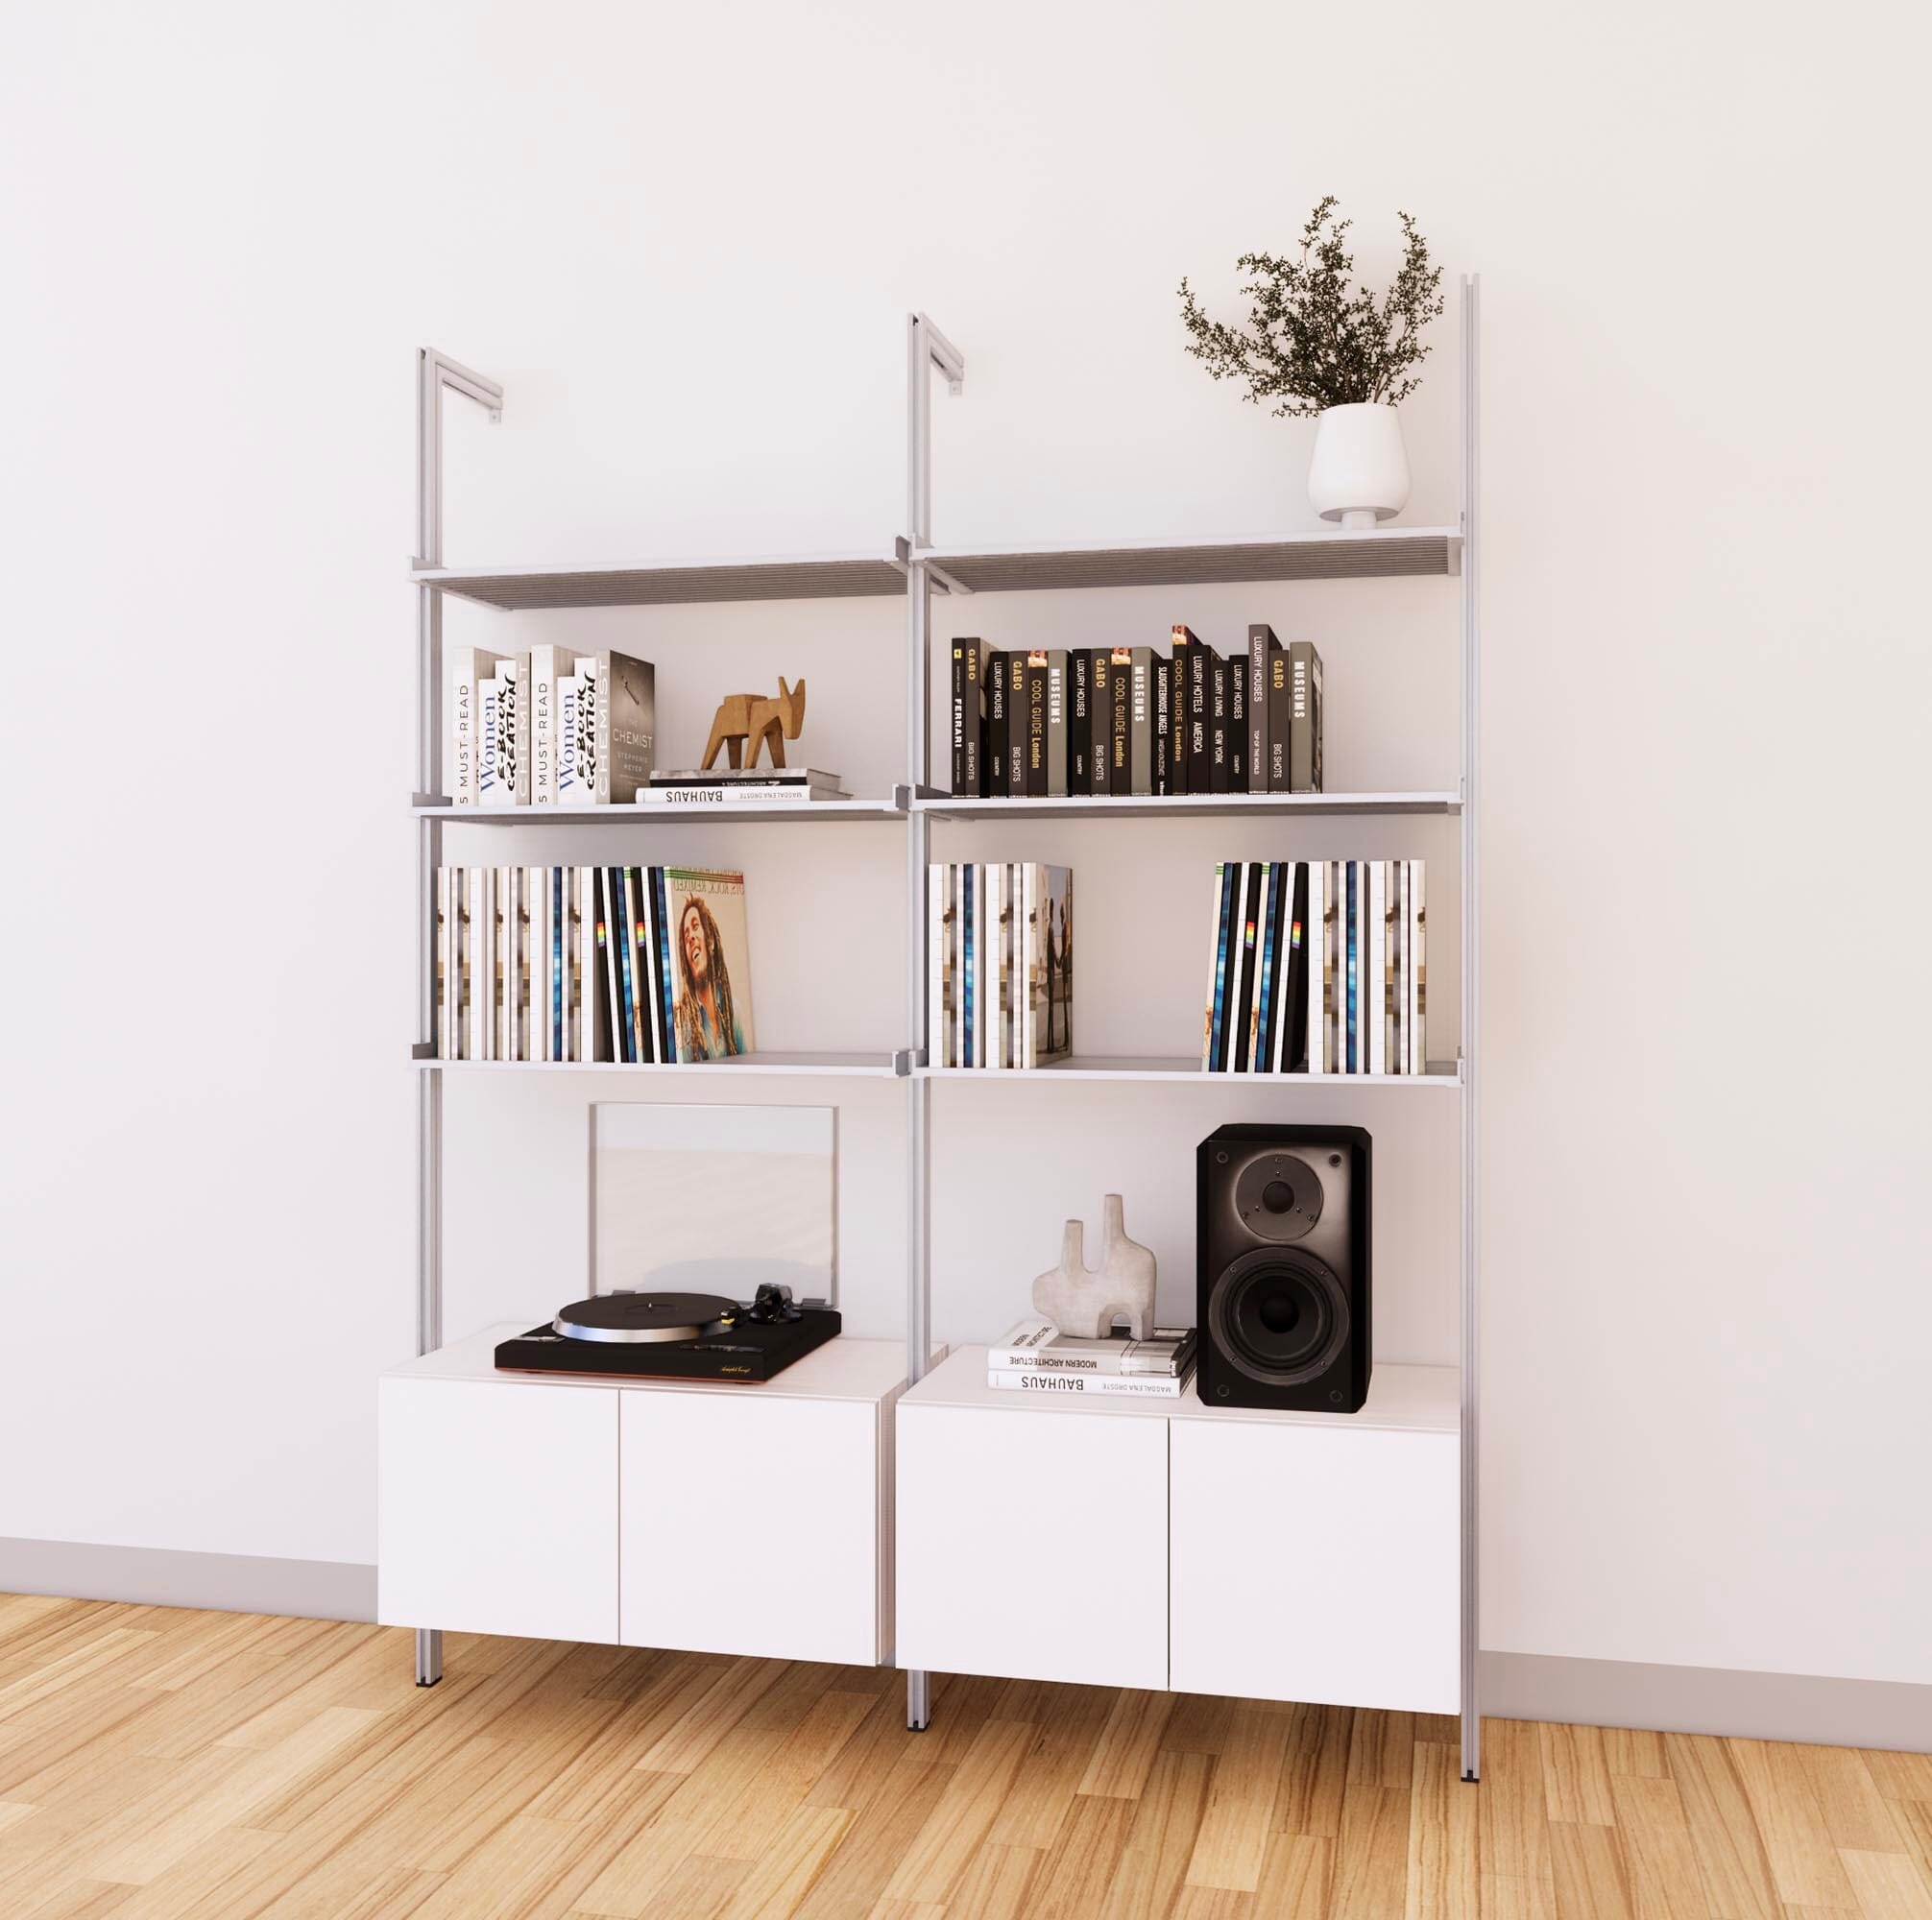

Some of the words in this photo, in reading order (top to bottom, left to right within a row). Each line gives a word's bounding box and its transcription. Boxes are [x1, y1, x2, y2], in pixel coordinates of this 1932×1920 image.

[1254, 636, 1262, 667] LUXURY
[994, 662, 1002, 690] LUXURY
[1013, 661, 1022, 690] GABO
[1077, 660, 1085, 687] LUXURY
[1096, 659, 1105, 688] GABO
[1193, 656, 1202, 684] LUXURY
[1215, 670, 1223, 695] LUXURY
[1234, 665, 1242, 691] LUXURY
[1273, 661, 1283, 689] GABO
[1032, 680, 1041, 704] COOL
[1051, 668, 1061, 724] MUSEUMS
[1115, 677, 1125, 702] COOL
[1135, 666, 1145, 722] MUSEUMS
[1193, 686, 1202, 713] HOTELS
[1254, 669, 1262, 702] HOUSES
[1295, 662, 1305, 718] MUSEUMS
[994, 691, 1002, 720] HOUSES
[1077, 688, 1085, 717] HOUSES
[1215, 696, 1223, 717] LIVING
[1234, 692, 1242, 720] HOUSES
[497, 685, 507, 779] E-BOOK
[504, 671, 516, 792] CREATION
[519, 663, 529, 796] CHEMIST
[577, 684, 587, 779] E-BOOK
[584, 671, 596, 791] CREATION
[598, 660, 607, 796] CHEMIST
[954, 698, 962, 747] FERRARI
[1032, 707, 1041, 734] GUIDE
[1115, 705, 1125, 732] GUIDE
[1158, 715, 1167, 735] ANGELS
[459, 684, 469, 787] MUST-READ
[480, 696, 496, 792] Women
[538, 683, 547, 786] MUST-READ
[559, 694, 575, 792] Women
[613, 728, 653, 749] CHEMIST
[1193, 722, 1202, 753] AMERICA
[1013, 746, 1021, 760] BIG
[1032, 738, 1041, 768] London
[1096, 744, 1104, 758] BIG
[1116, 735, 1125, 767] London
[1273, 744, 1282, 755] BIG
[1013, 761, 1021, 782] SHOTS
[1096, 759, 1104, 781] SHOTS
[1273, 756, 1282, 778] SHOTS
[538, 795, 547, 804] 5
[666, 791, 723, 803] BAUHAUS
[1009, 1357, 1063, 1367] ARCHITECTURE
[1066, 1360, 1097, 1368] MODERN
[1021, 1376, 1084, 1390] BAUHAUS
